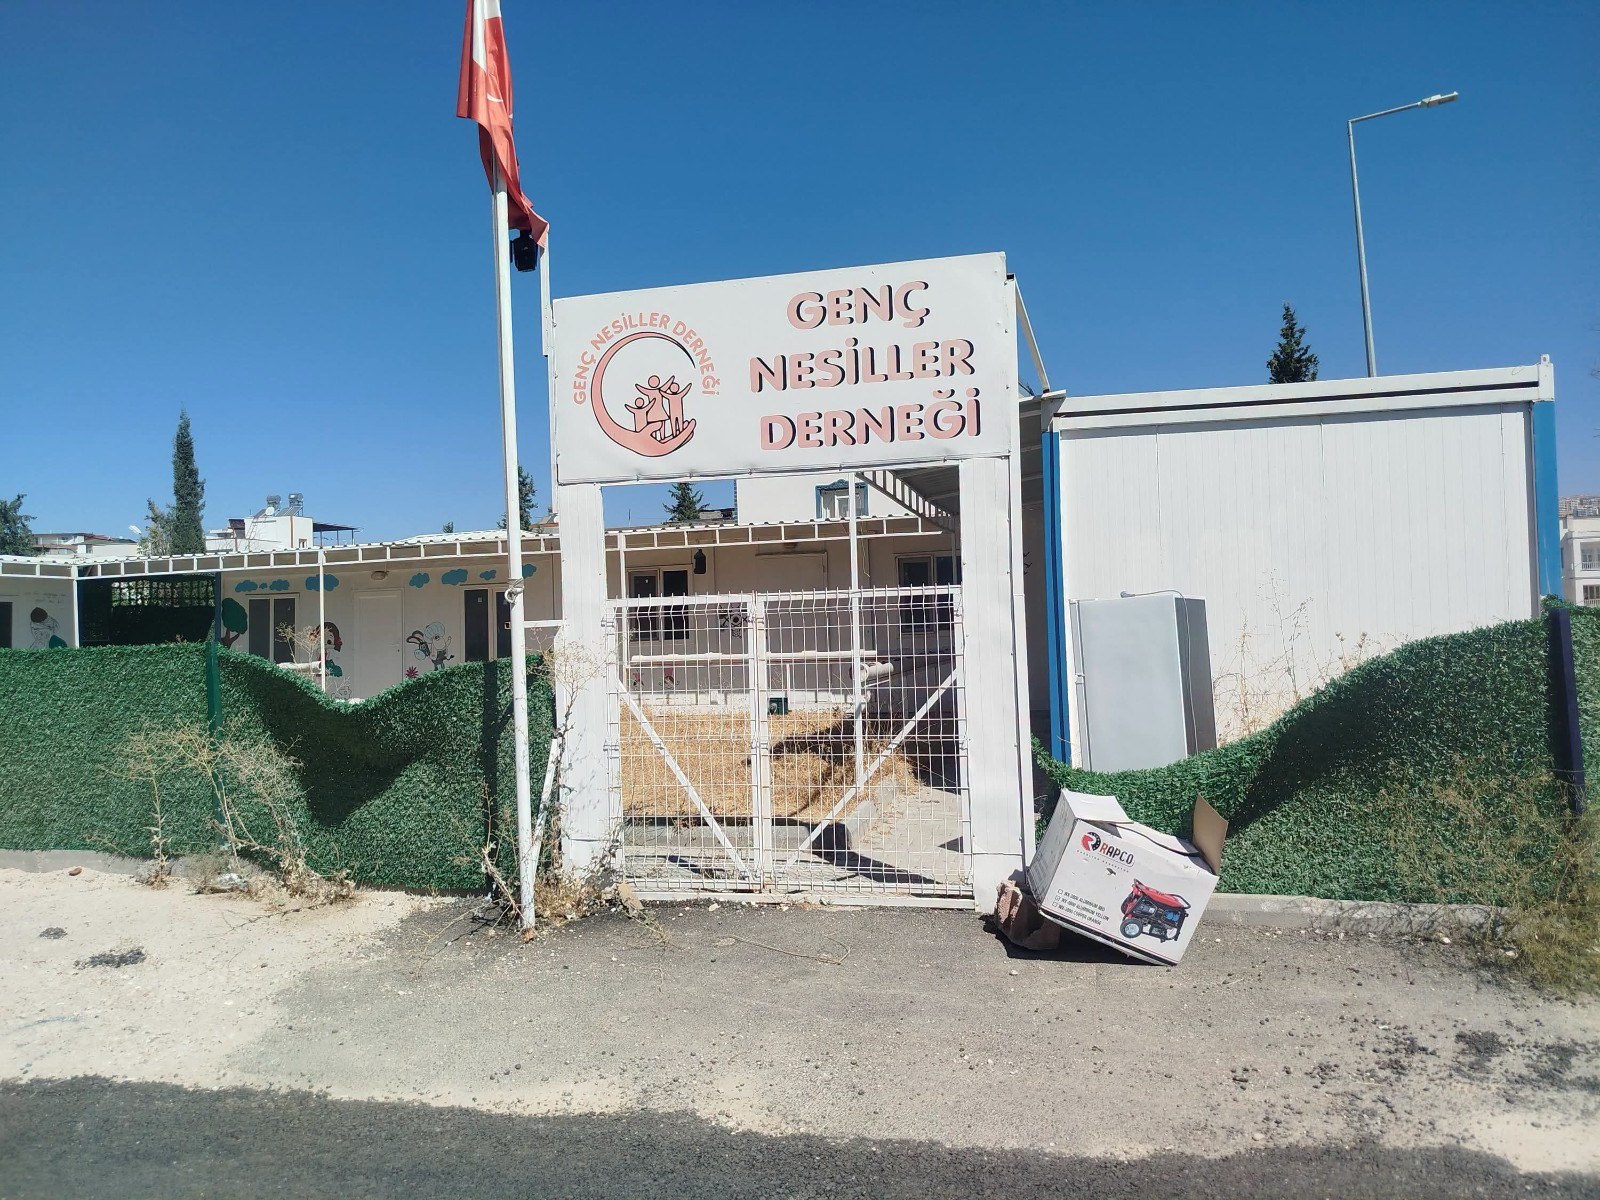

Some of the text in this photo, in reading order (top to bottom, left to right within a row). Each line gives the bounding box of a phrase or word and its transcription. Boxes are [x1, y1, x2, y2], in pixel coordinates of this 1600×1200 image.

[787, 280, 930, 329] GENÇ
[573, 312, 721, 405] GENÇ NESİLLER DERNEĞİ
[749, 337, 975, 393] NESİLLER
[760, 387, 981, 451] DERNEĞİ
[1099, 842, 1134, 865] RAPCO
